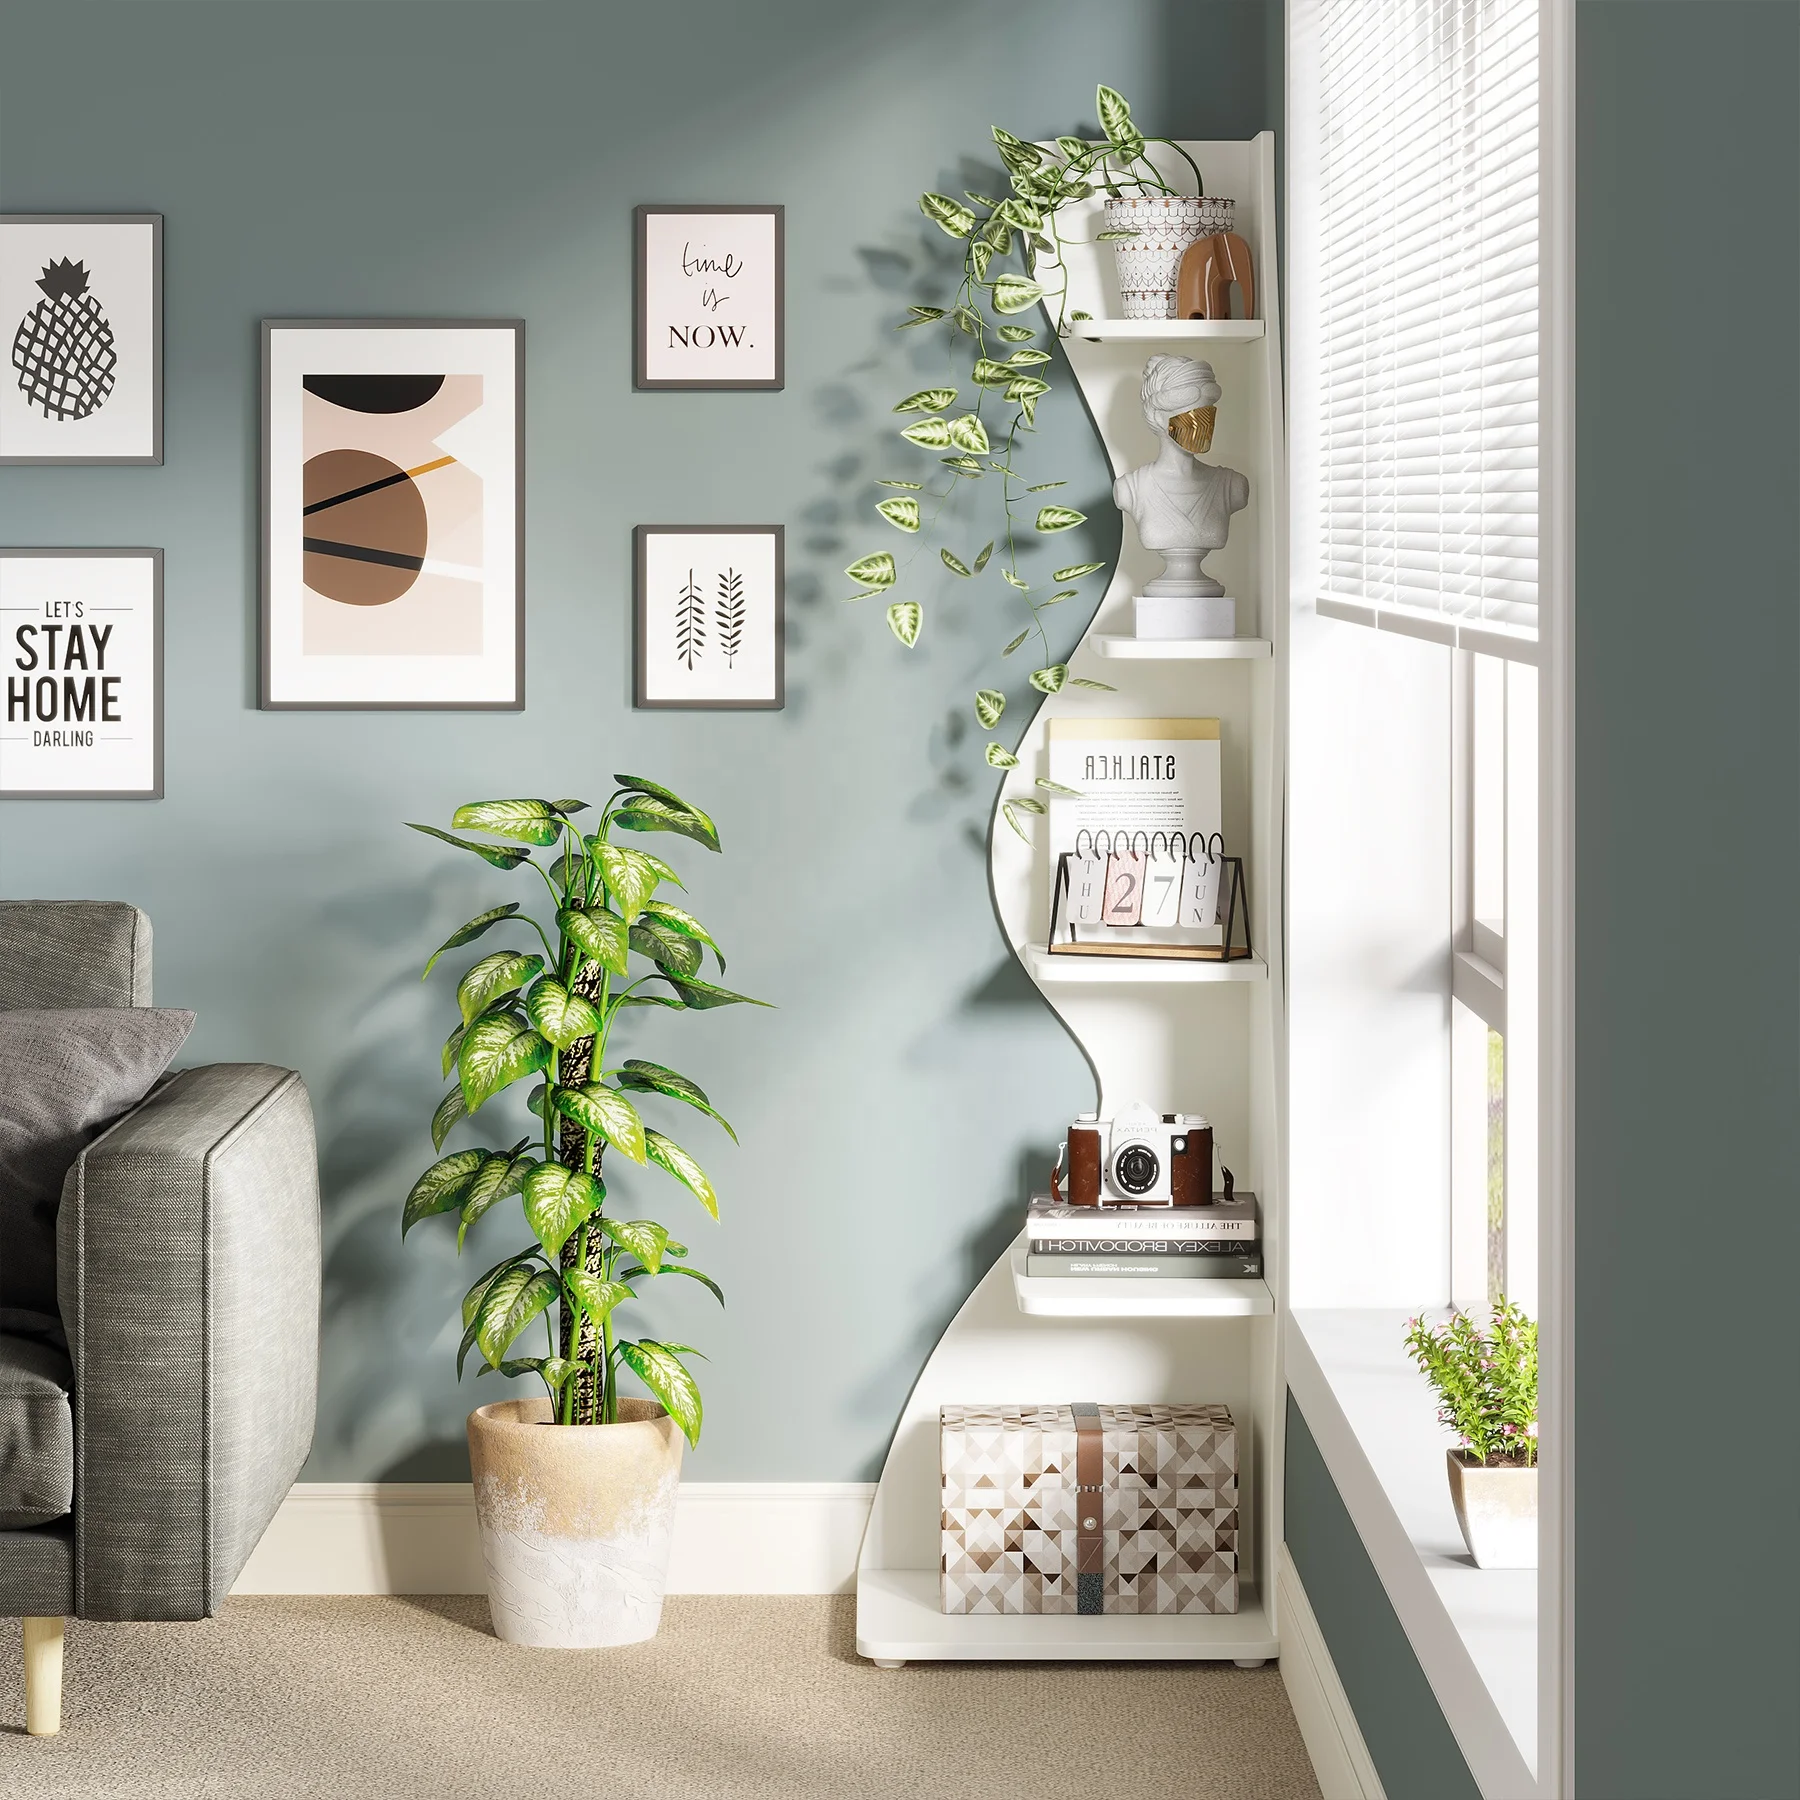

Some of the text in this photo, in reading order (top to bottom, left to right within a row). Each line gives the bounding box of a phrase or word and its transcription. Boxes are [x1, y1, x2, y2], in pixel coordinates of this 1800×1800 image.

[681, 241, 743, 278] time
[702, 282, 730, 312] is
[668, 325, 754, 348] NOW.
[45, 600, 84, 618] LET'S
[15, 624, 113, 671] STAY
[8, 676, 121, 722] HOME
[33, 730, 94, 747] DARLING
